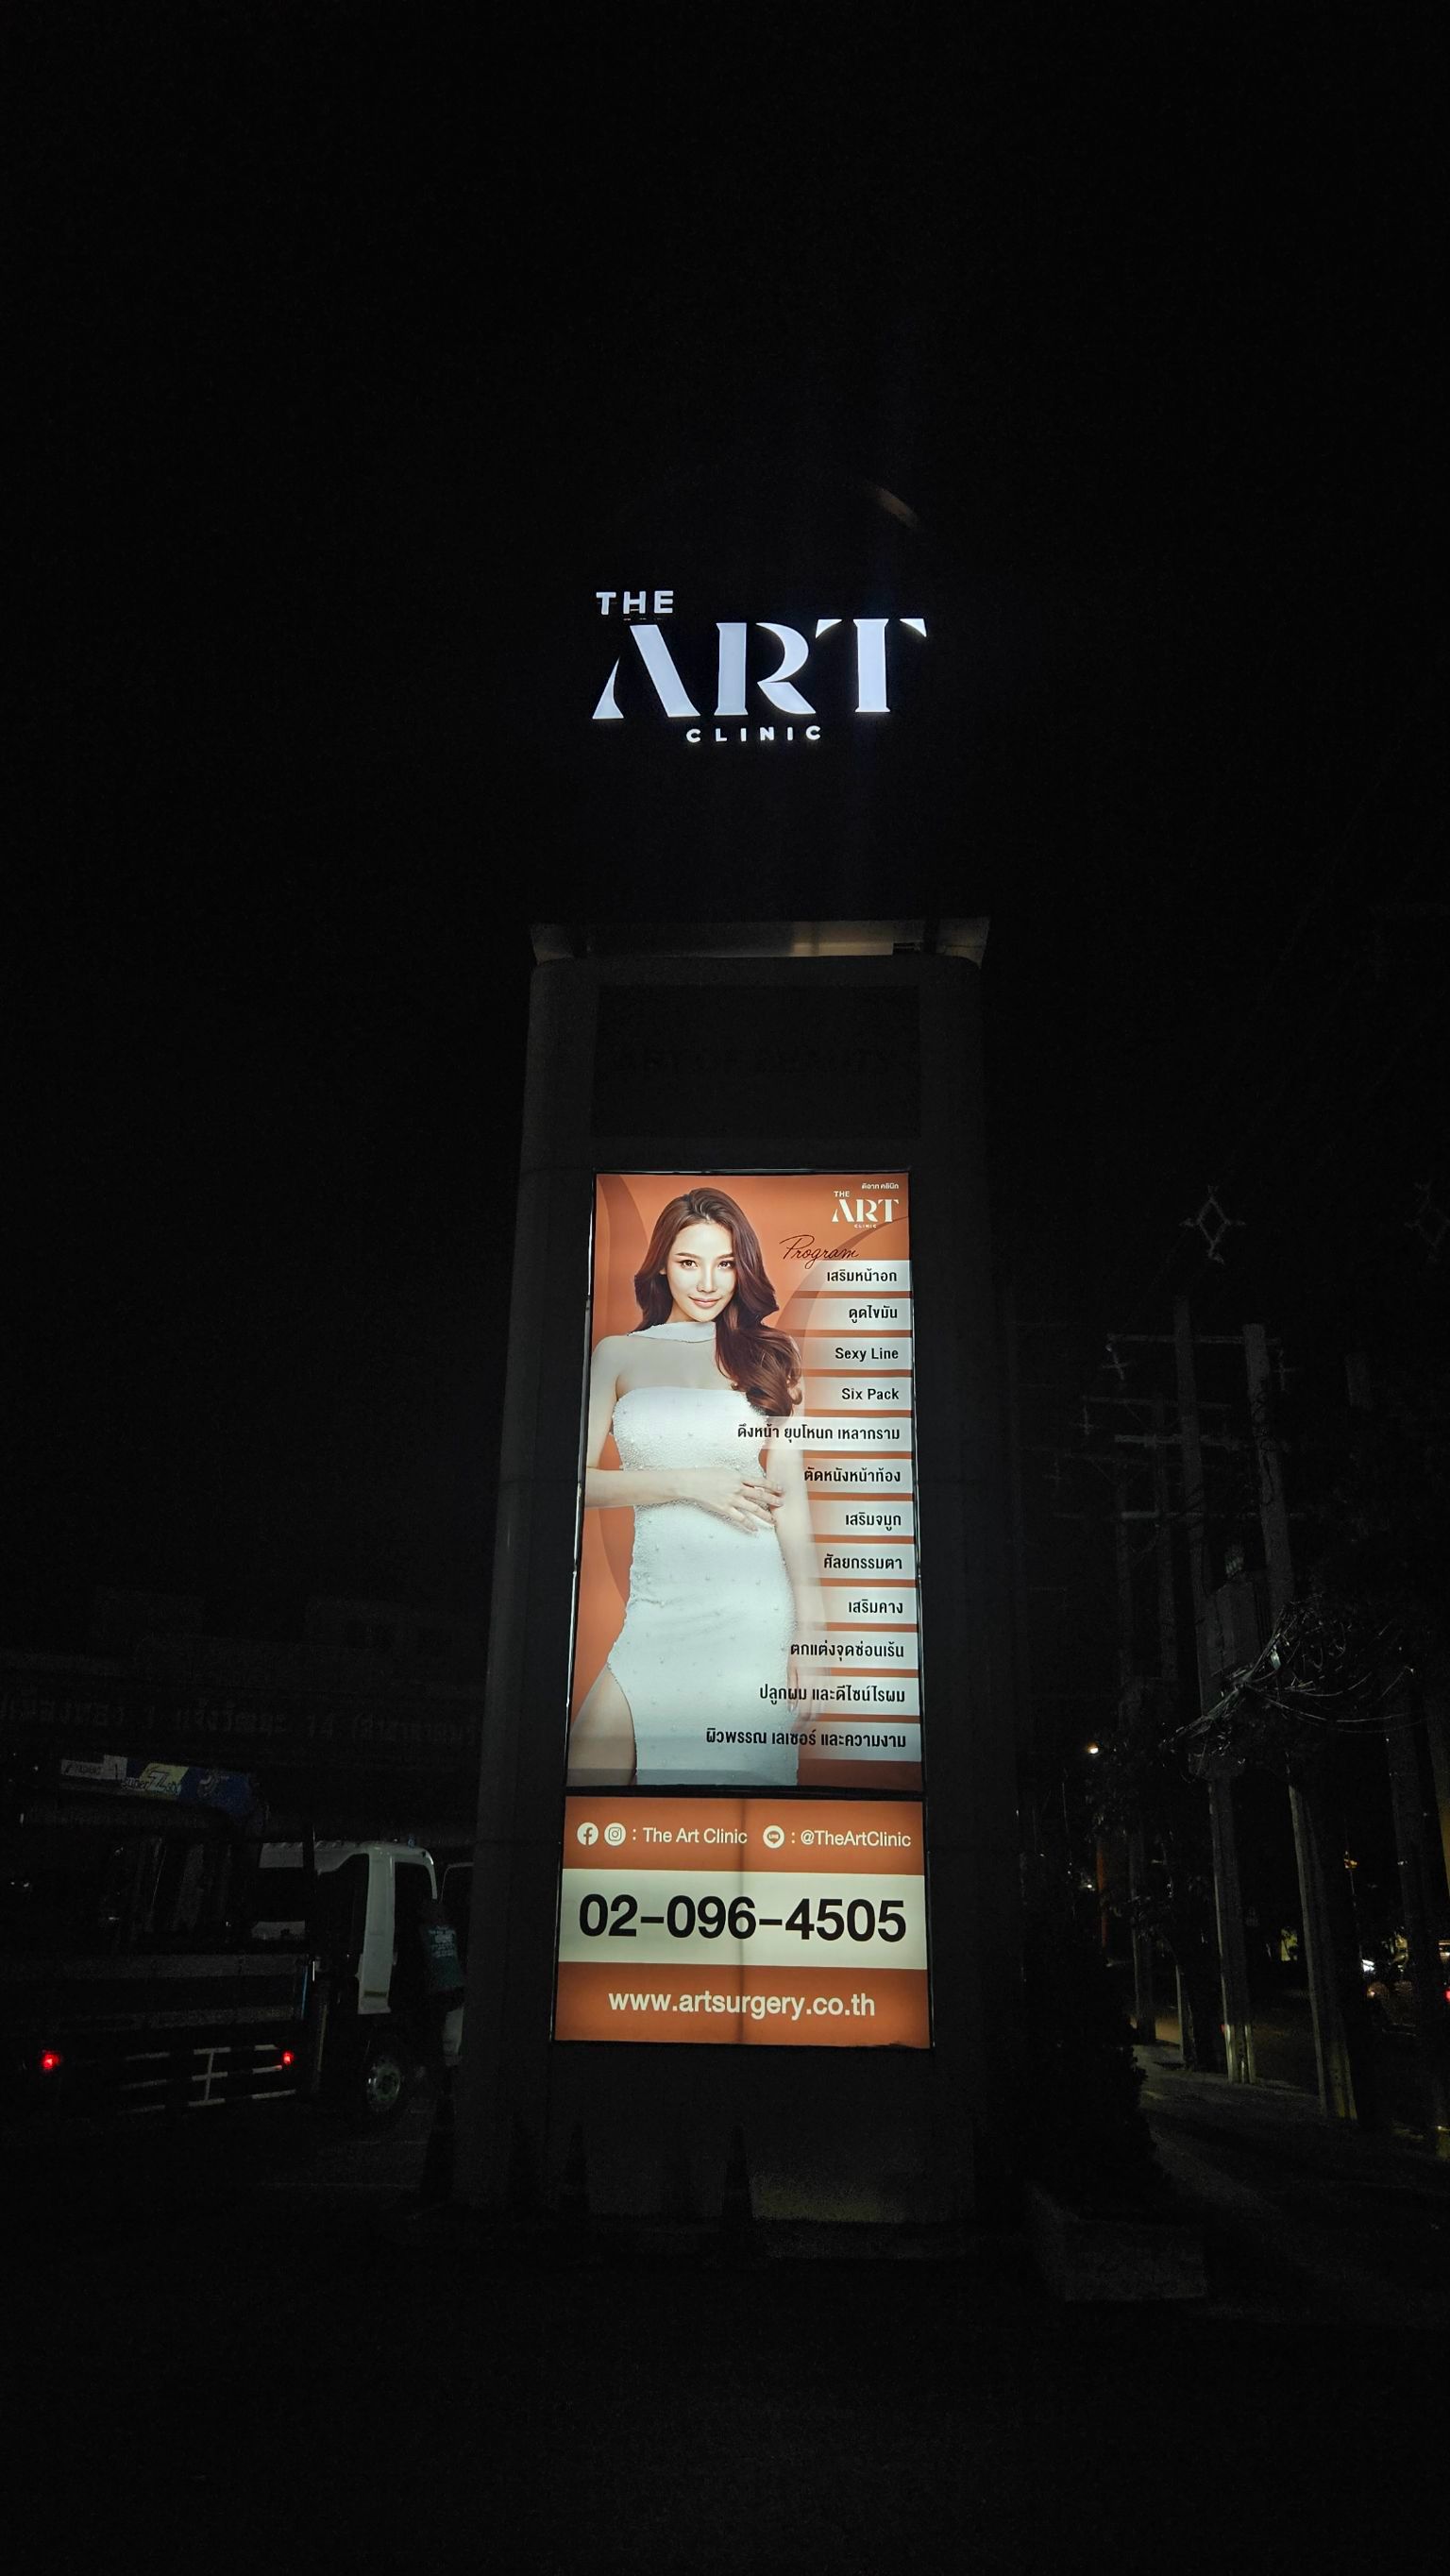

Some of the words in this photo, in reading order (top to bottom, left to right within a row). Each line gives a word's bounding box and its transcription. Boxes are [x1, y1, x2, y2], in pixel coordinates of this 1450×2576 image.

[596, 589, 675, 615] THE
[592, 619, 927, 720] ART
[685, 725, 821, 743] CLINIC
[832, 1199, 900, 1222] ART
[779, 1234, 860, 1269] Program
[827, 1268, 897, 1281] เสริมหน้าอก
[849, 1304, 898, 1323] ดูดไขมัน
[835, 1347, 867, 1362] Sexy
[871, 1347, 899, 1359] Line
[841, 1387, 863, 1399] Six
[867, 1387, 900, 1399] Pack
[737, 1423, 780, 1438] ดึงหน้า
[784, 1424, 833, 1443] ยุบโหนก
[837, 1427, 900, 1440] เหลากราม
[803, 1466, 901, 1483] ตัดหนังหน้าท้อง
[845, 1512, 902, 1532] เสริมจมูก
[823, 1553, 902, 1569] ศัลยกรรมตา
[848, 1599, 903, 1614] เสริมคาง
[790, 1639, 904, 1662] ตกแต่งจุดซ่อนเร้น
[759, 1684, 807, 1705] ปลูกผม
[812, 1685, 905, 1703] และดีไซน์ไรผม
[706, 1727, 767, 1744] ผิวพรรณ
[771, 1729, 817, 1746] เลเซอร์
[820, 1733, 906, 1748] และความงาม
[643, 1827, 672, 1842] The
[676, 1828, 700, 1842] Art
[703, 1828, 748, 1844] Clinic
[801, 1829, 912, 1848] @TheArtClinic
[579, 1894, 906, 1942] 02-096-4505
[609, 1991, 875, 2021] www.artsurgery.co.th
